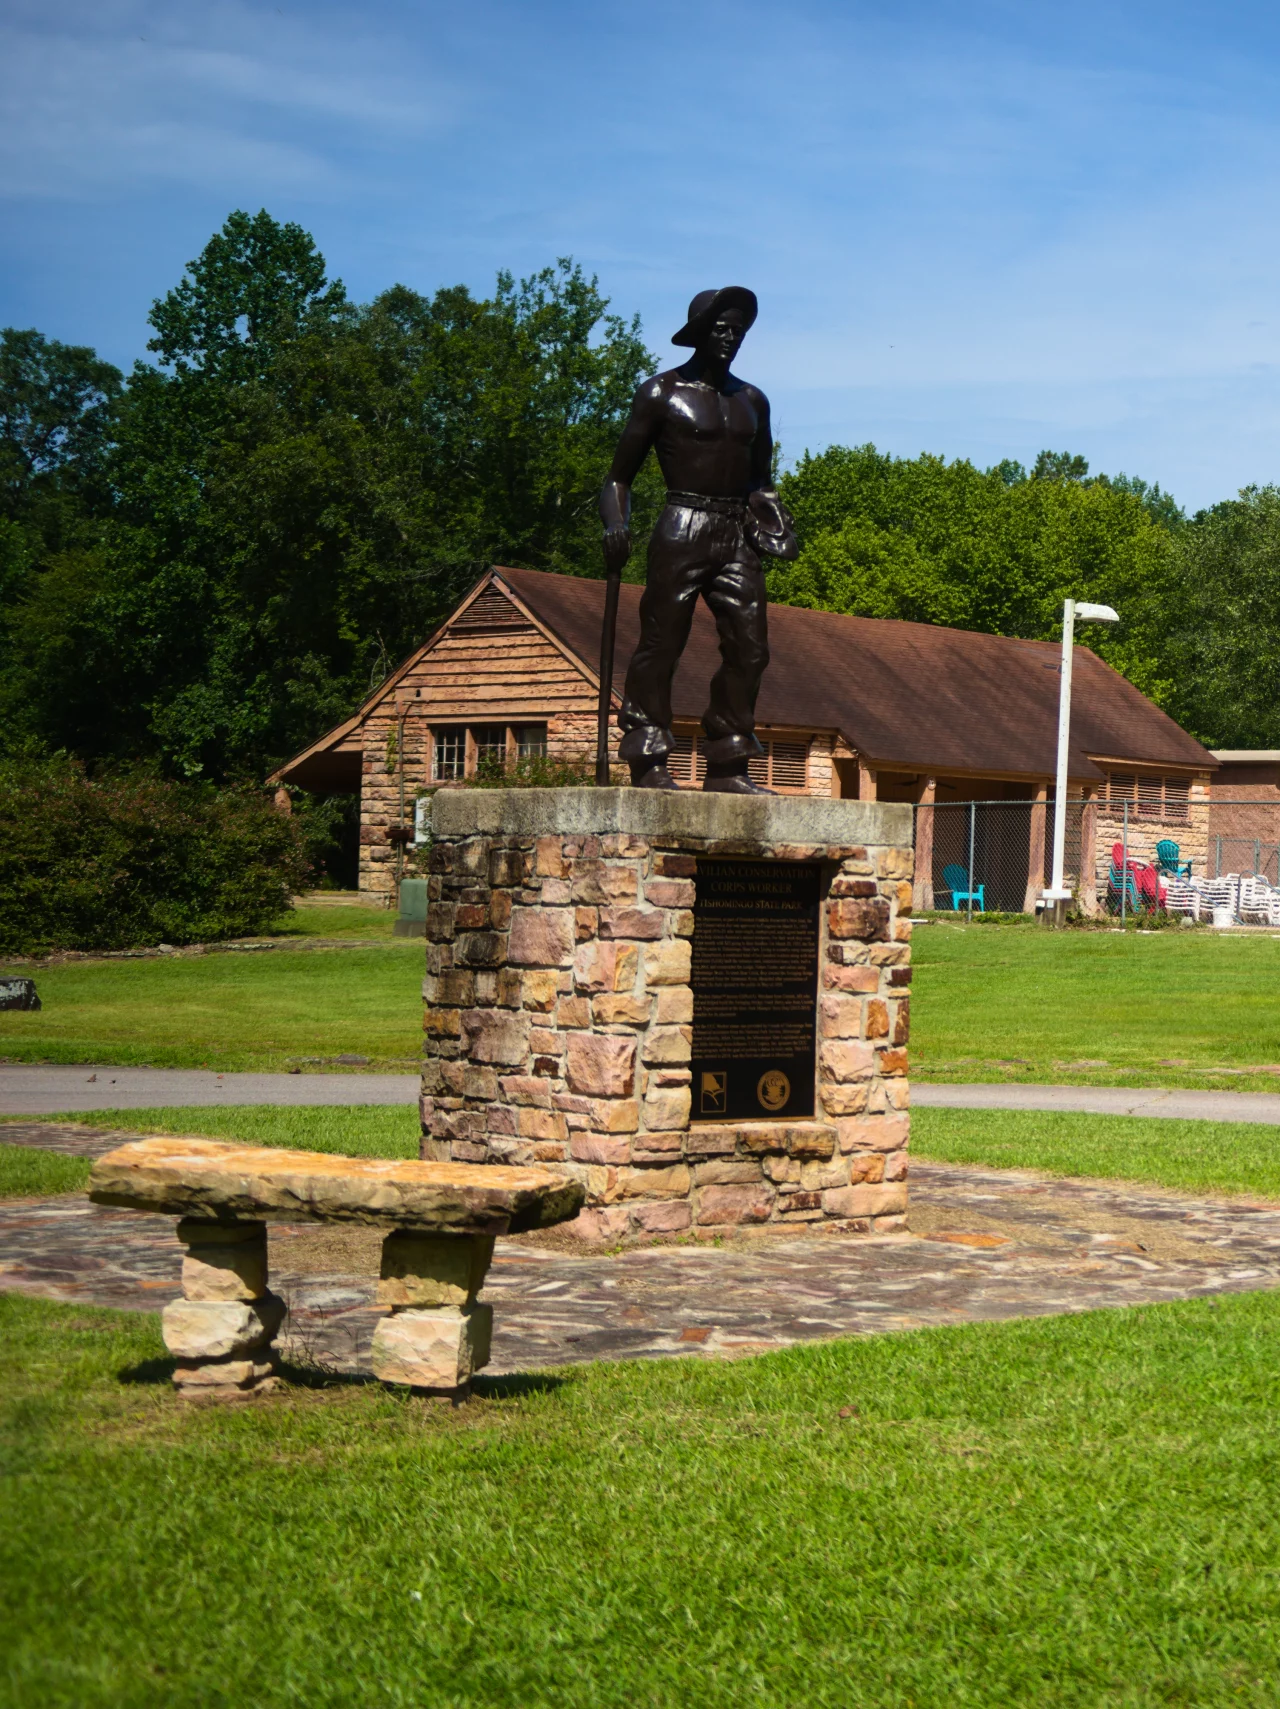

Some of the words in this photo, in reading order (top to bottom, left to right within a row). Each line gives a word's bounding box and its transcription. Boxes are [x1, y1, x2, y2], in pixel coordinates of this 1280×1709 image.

[698, 865, 735, 876] VILIAN
[738, 867, 815, 878] CONSERVATION
[711, 881, 745, 892] CORPS
[748, 882, 792, 893] WORKER
[700, 899, 753, 908] TISHOMINGO
[755, 899, 780, 909] STATE
[781, 900, 803, 910] PARK
